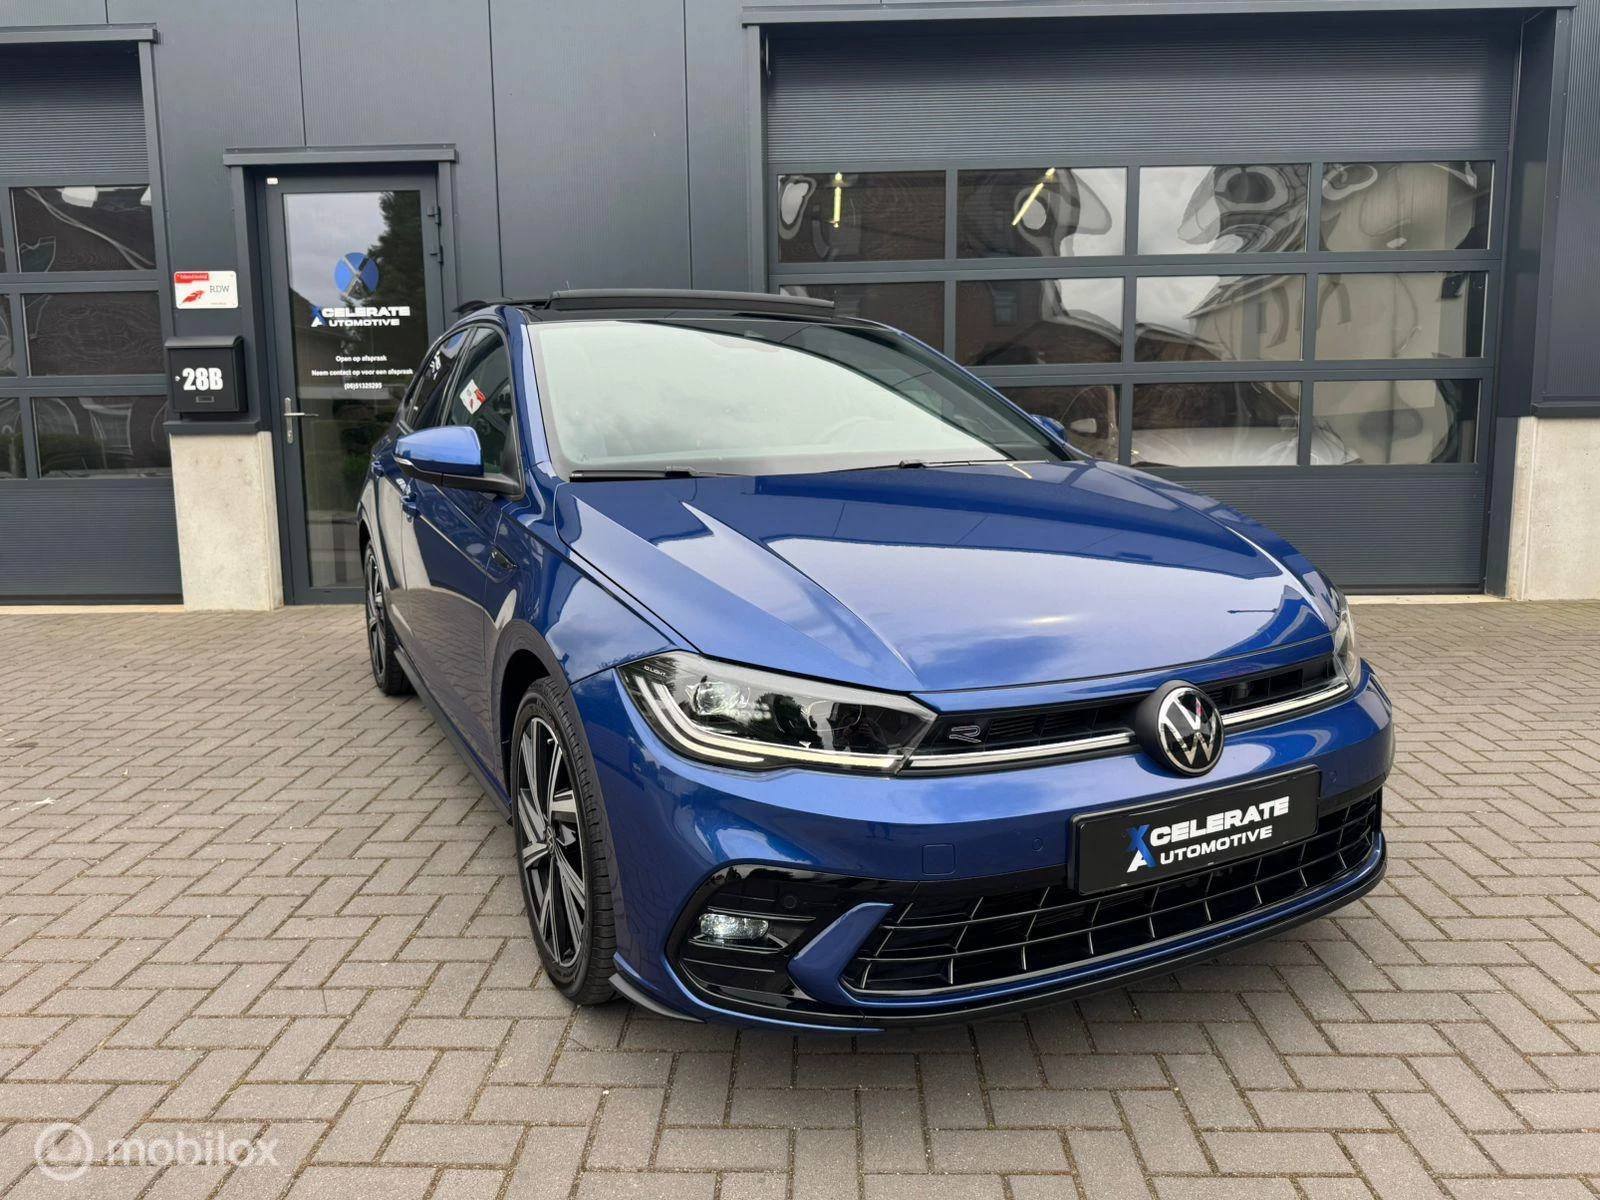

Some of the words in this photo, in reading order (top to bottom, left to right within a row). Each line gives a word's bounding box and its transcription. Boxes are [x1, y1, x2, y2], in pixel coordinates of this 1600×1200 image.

[209, 285, 230, 293] RDW
[181, 367, 224, 391] 28B
[352, 369, 360, 377] op
[388, 368, 413, 376] afspraak
[1126, 796, 1290, 862] XCELERATE
[1126, 825, 1273, 873] AUTOMOTIVE
